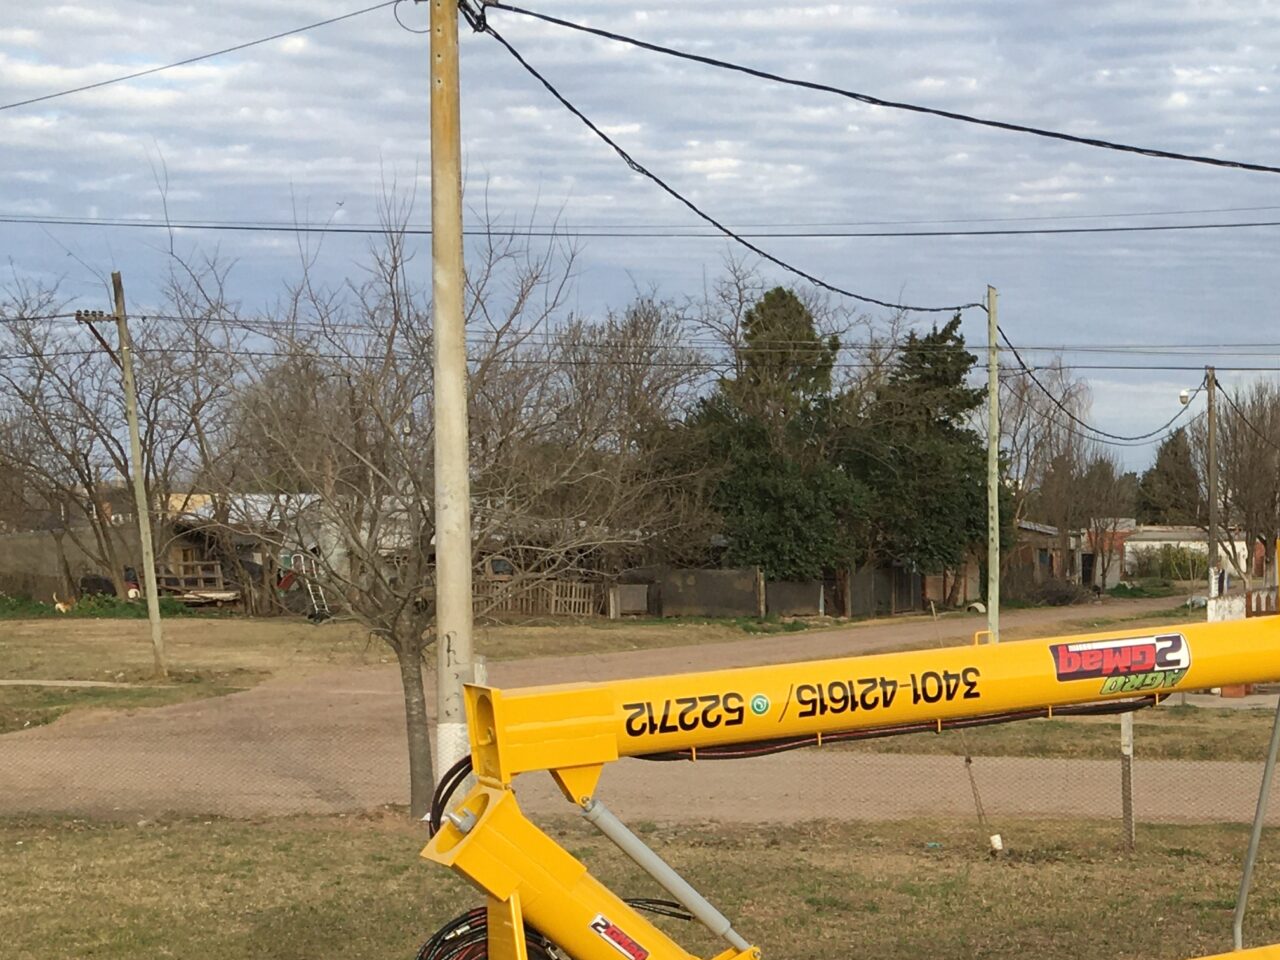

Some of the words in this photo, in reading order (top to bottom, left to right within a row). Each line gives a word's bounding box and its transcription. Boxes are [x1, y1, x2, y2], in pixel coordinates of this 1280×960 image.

[1057, 633, 1182, 675] 2GMaq
[1100, 668, 1186, 695] AGRO
[623, 692, 745, 737] 522712
